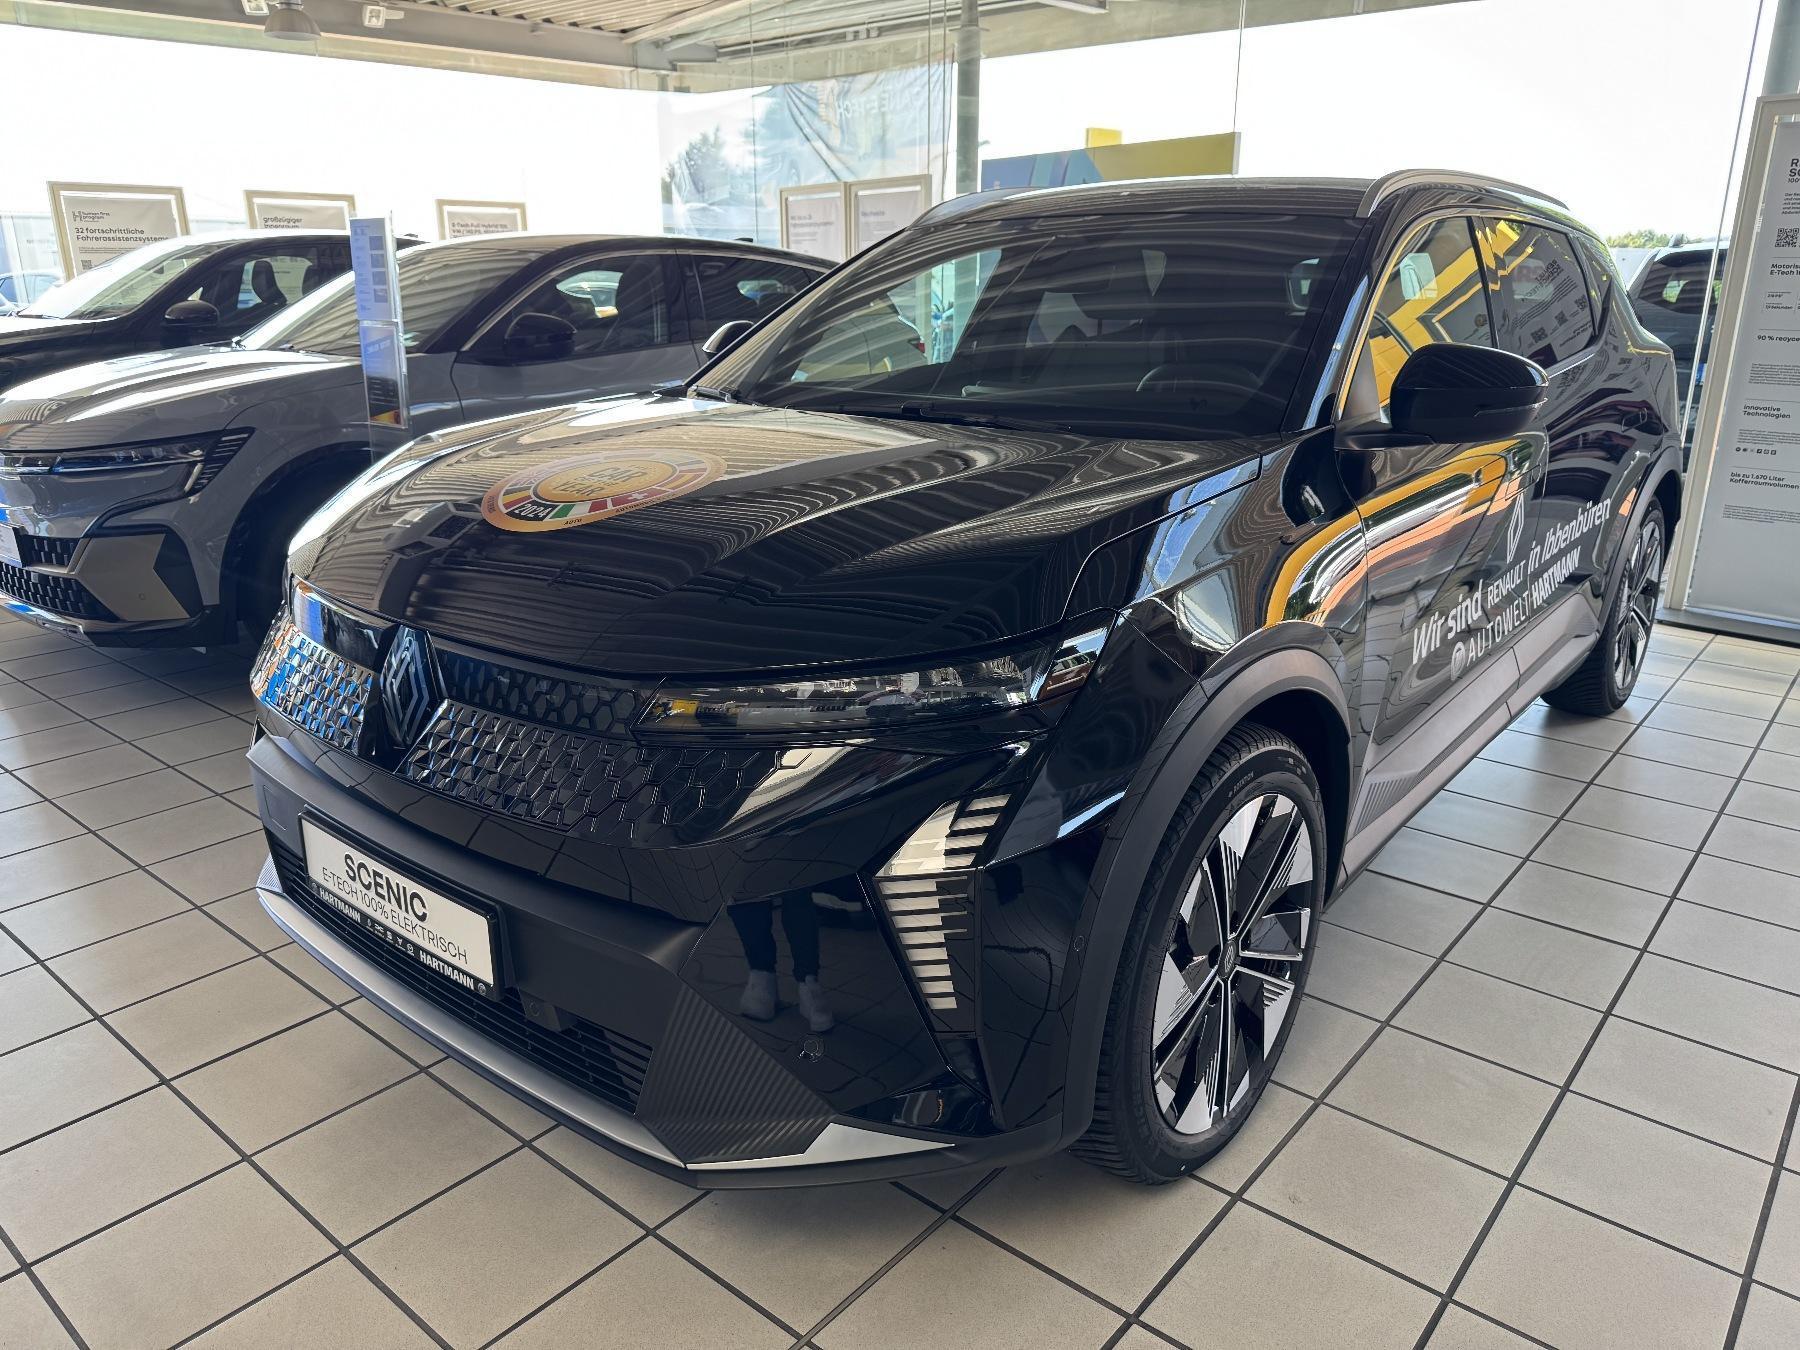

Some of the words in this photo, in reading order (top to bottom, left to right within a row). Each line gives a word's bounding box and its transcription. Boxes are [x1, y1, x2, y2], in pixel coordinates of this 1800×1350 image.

[86, 227, 145, 235] fortschrittliche
[1743, 404, 1781, 412] innovative
[1743, 410, 1791, 419] Technologien
[553, 481, 605, 496] YEAR
[513, 503, 553, 518] 2024
[1412, 611, 1446, 665] Wir
[1447, 579, 1483, 640] sind
[1487, 560, 1526, 609] RENAULT
[1528, 541, 1539, 575] in
[1541, 497, 1612, 563] Ibbenbüren
[1466, 590, 1530, 667] AUTOWELT
[1531, 546, 1581, 609] HARTMANN
[319, 887, 361, 923] HARTMANN
[344, 853, 428, 922] SCENIC
[322, 866, 359, 900] E-TECH
[360, 890, 389, 919] 100%
[391, 908, 469, 964] ELEKTRISCH
[419, 950, 475, 991] HARTMANN
